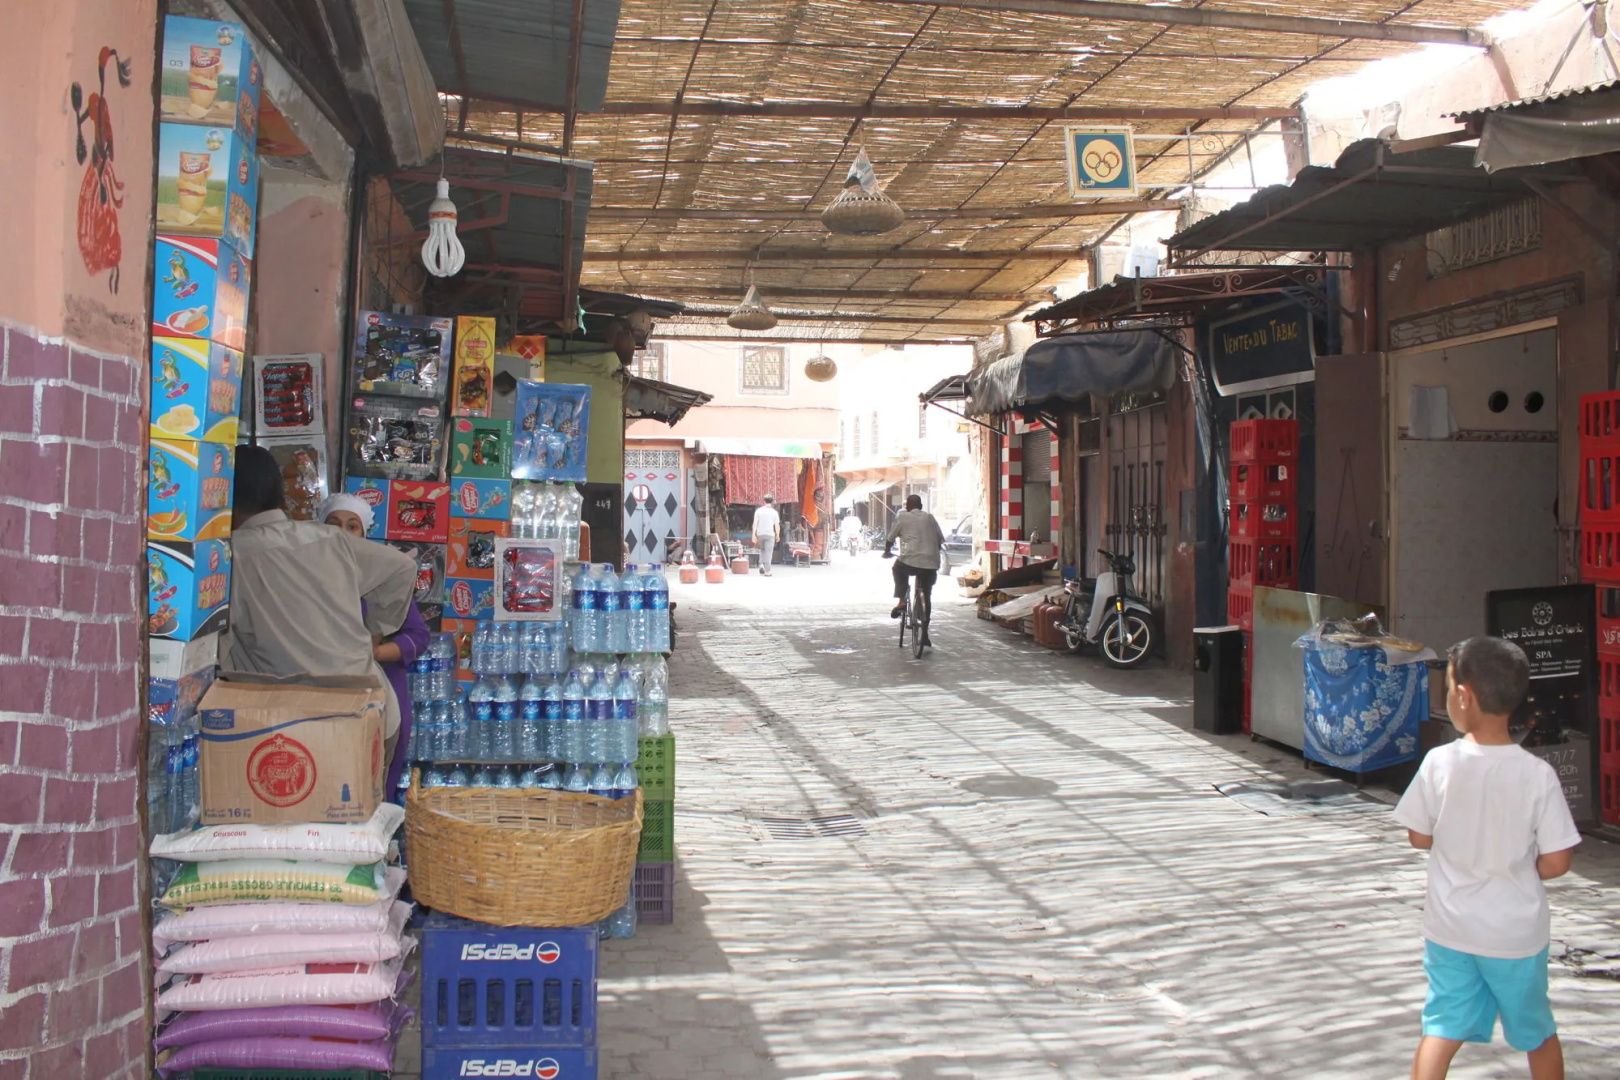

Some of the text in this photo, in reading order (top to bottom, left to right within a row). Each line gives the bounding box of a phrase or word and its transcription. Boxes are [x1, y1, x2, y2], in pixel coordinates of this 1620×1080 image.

[1269, 319, 1298, 343] TABAC
[1536, 650, 1552, 659] SPA
[1559, 764, 1578, 776] 20h
[228, 808, 241, 818] 16
[213, 829, 319, 838] Couscous Fin
[230, 880, 274, 890] GROSSE
[276, 880, 325, 893] SEMOULE
[461, 943, 535, 960] PEPSI
[460, 1059, 534, 1077] PEPSI
